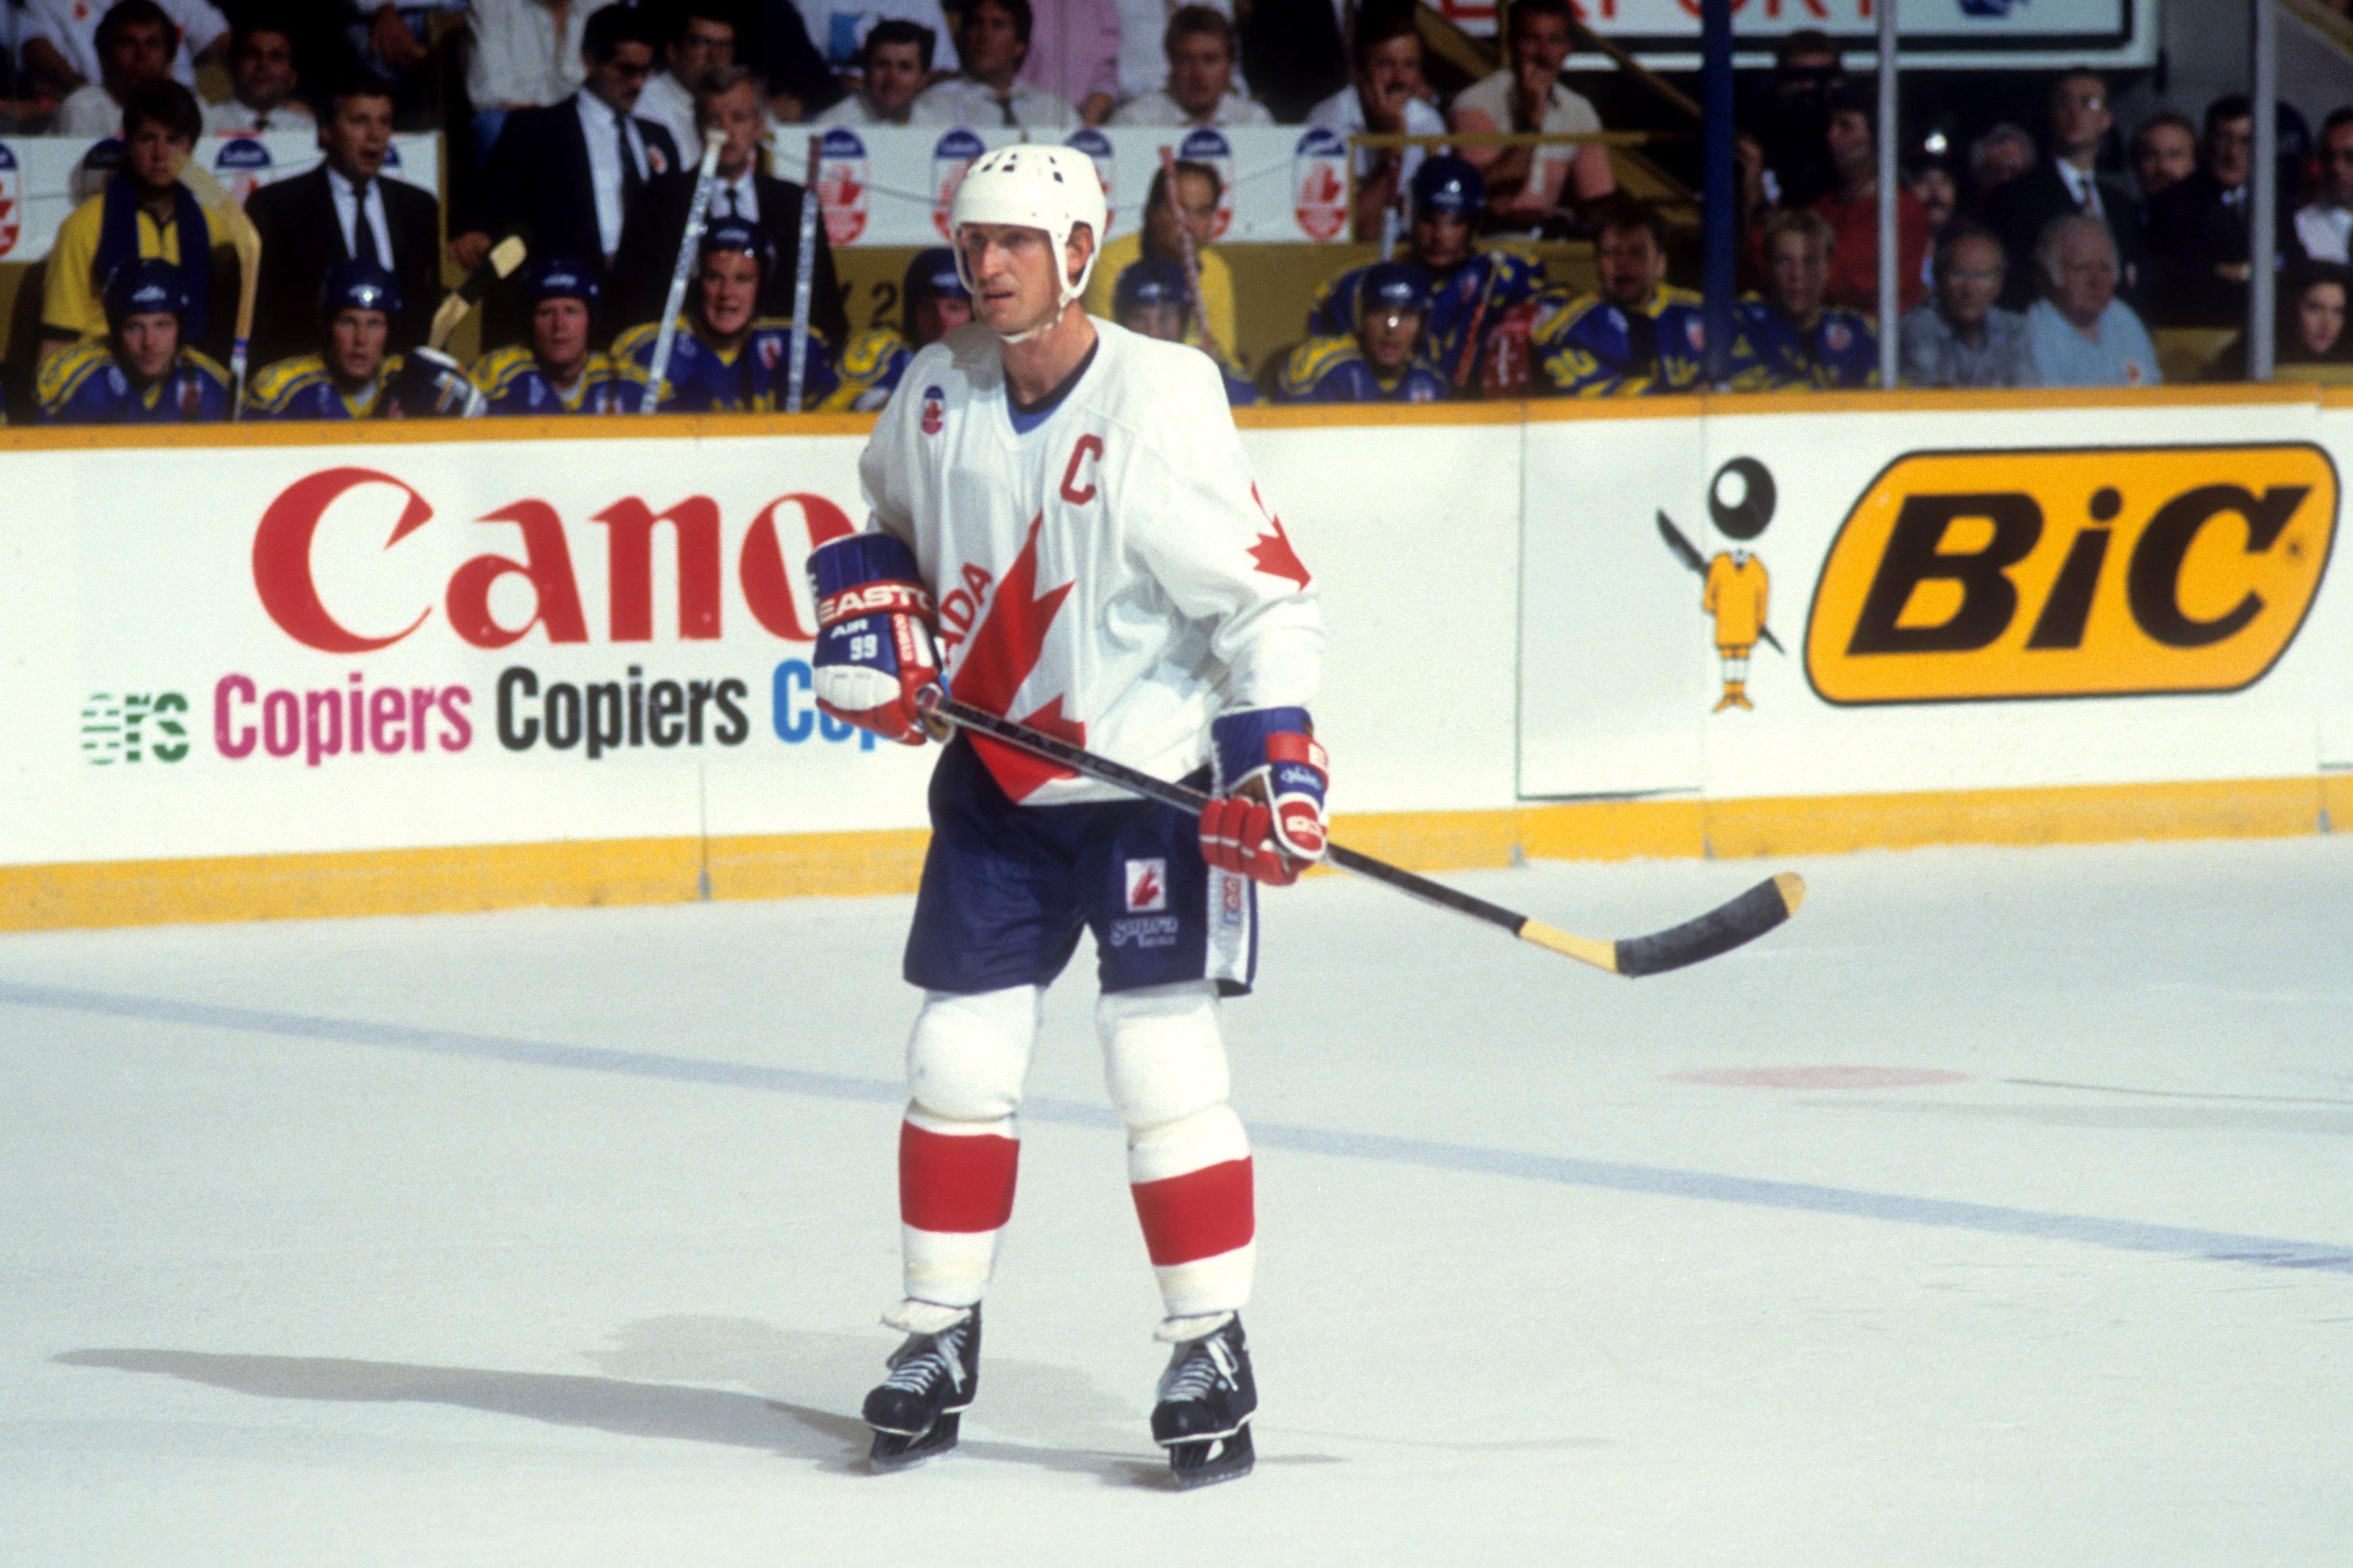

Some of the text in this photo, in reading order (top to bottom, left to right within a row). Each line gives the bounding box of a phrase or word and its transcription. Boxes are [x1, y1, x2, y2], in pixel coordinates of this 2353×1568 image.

[1060, 433, 1103, 505] C
[252, 465, 856, 654] Cano
[830, 618, 869, 640] AIR
[849, 633, 877, 661] 99
[213, 672, 473, 767] Copiers
[497, 665, 750, 759] Copiers
